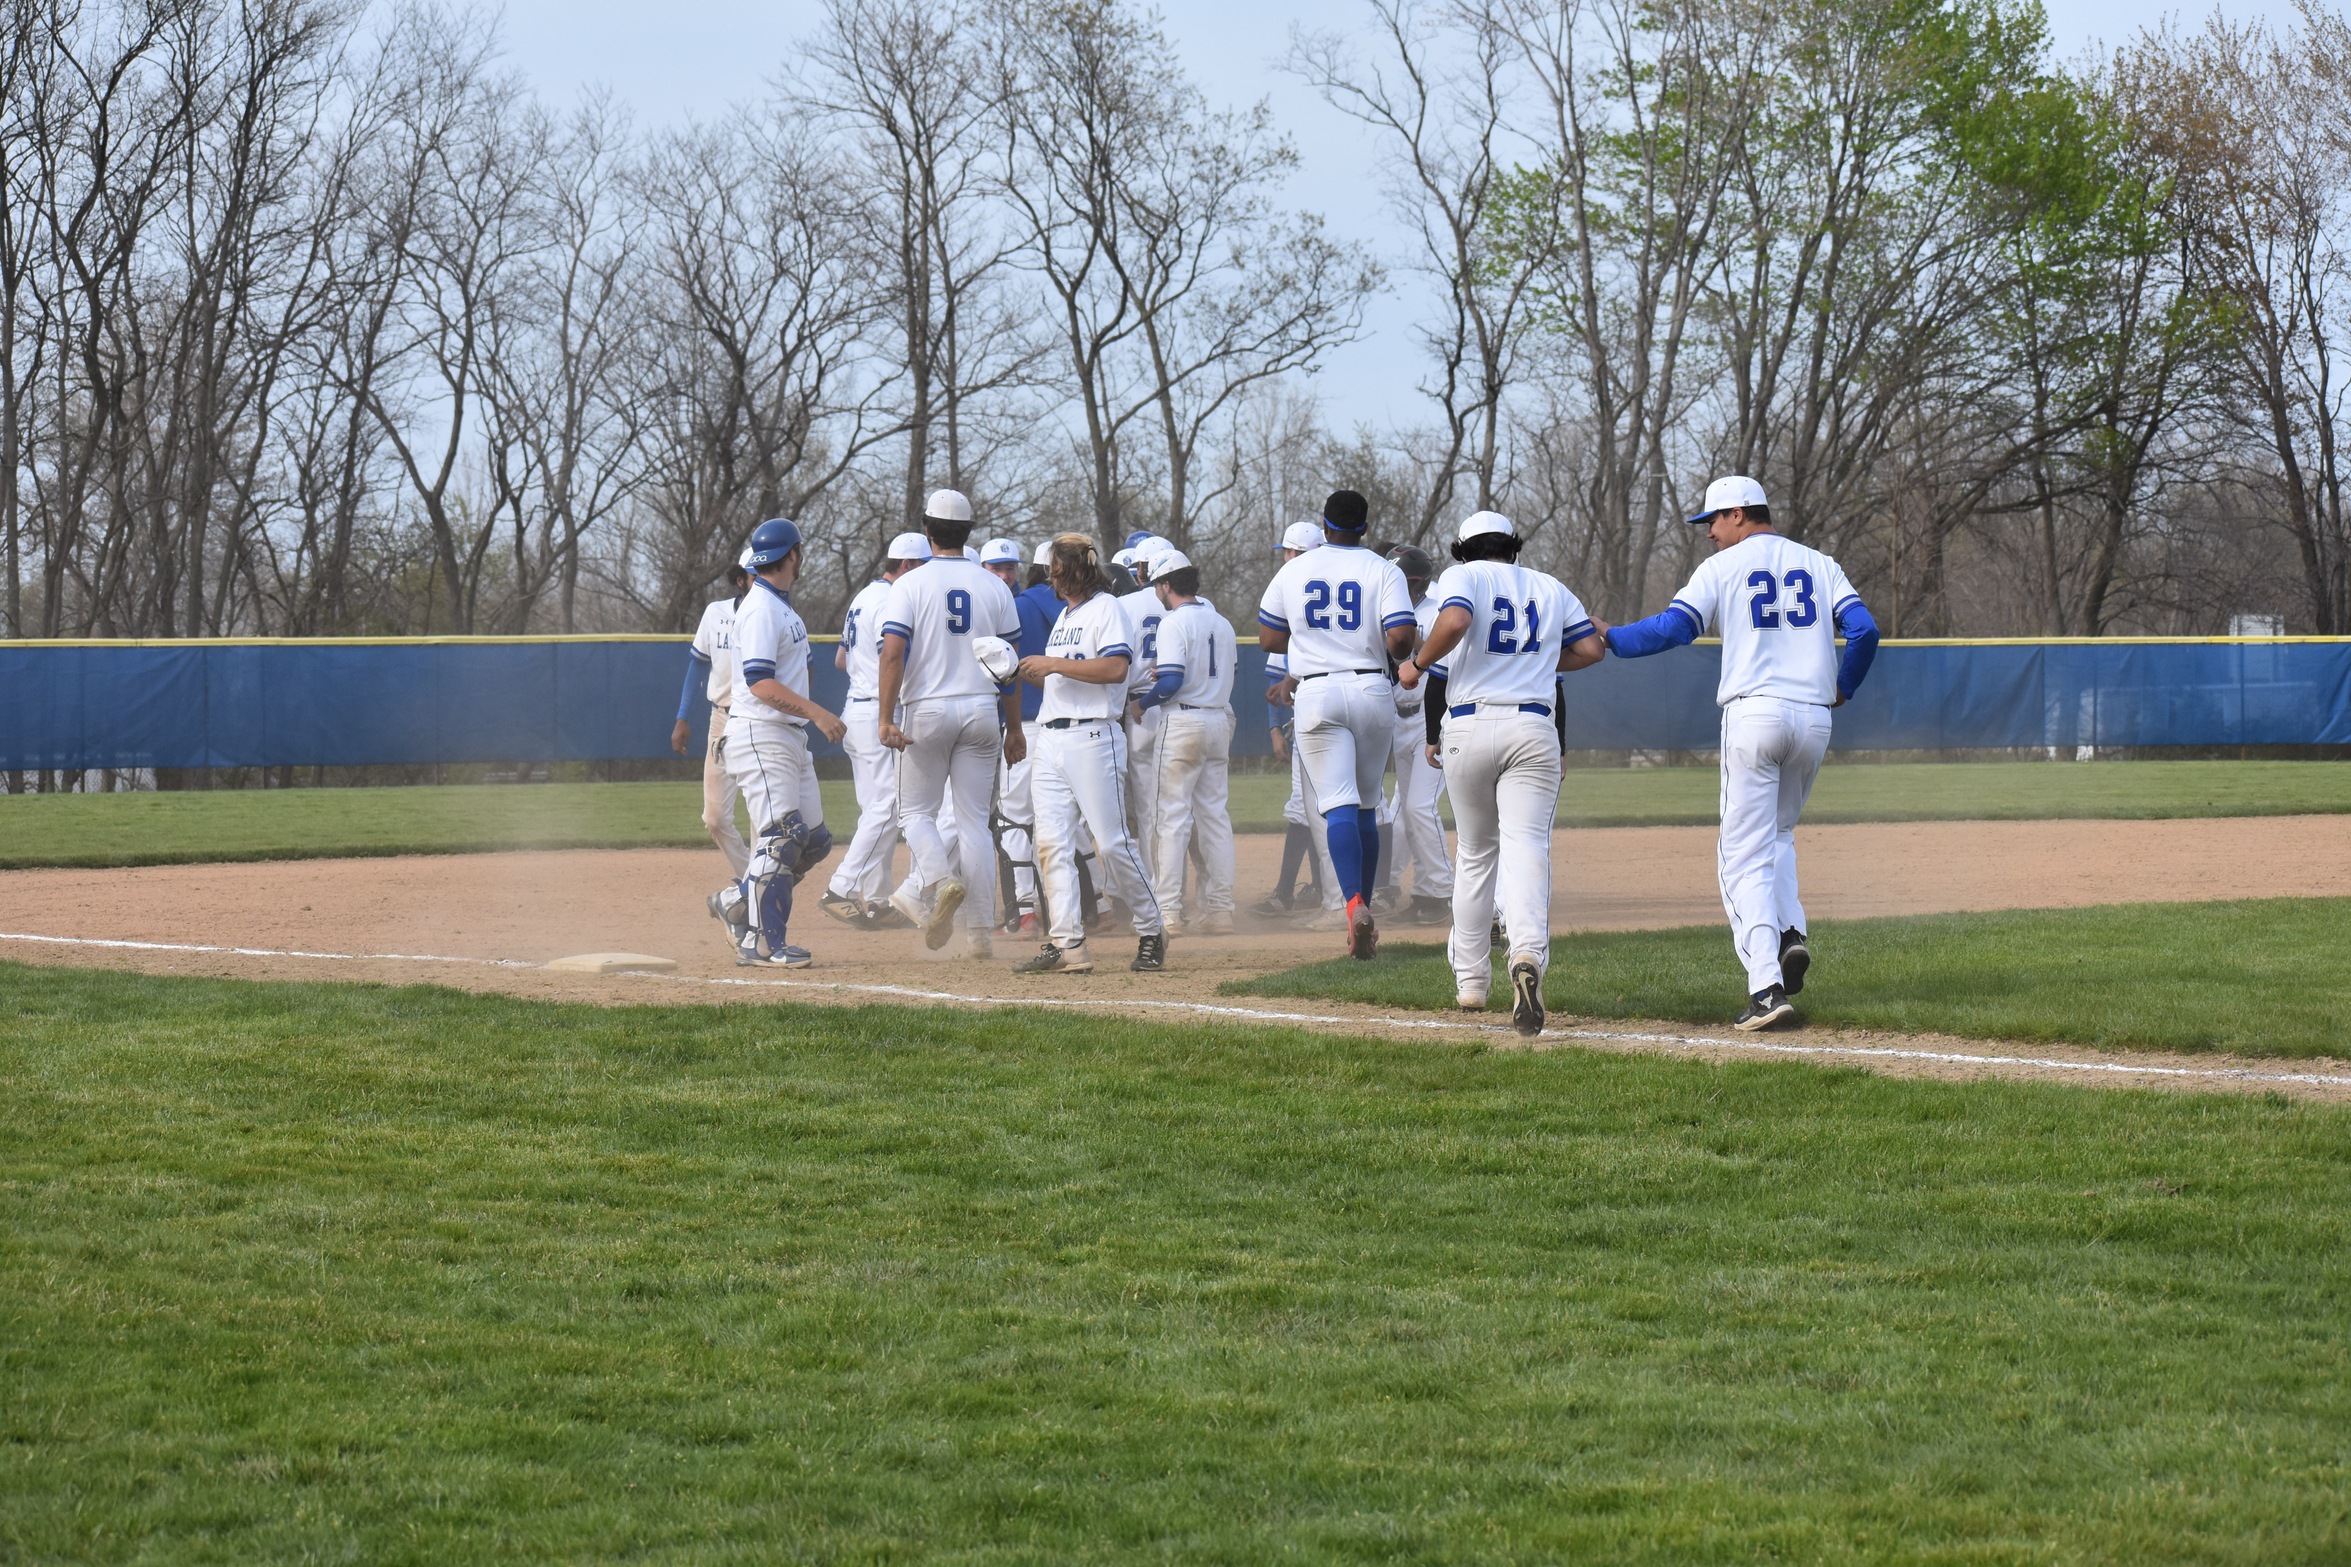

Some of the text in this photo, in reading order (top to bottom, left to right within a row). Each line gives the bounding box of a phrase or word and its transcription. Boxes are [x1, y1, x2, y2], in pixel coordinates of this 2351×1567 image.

[945, 587, 973, 636] 9
[1303, 578, 1364, 632] 29
[1745, 567, 1820, 631] 23
[717, 632, 730, 649] LA
[1485, 594, 1543, 656] 21
[1208, 631, 1218, 679] 1
